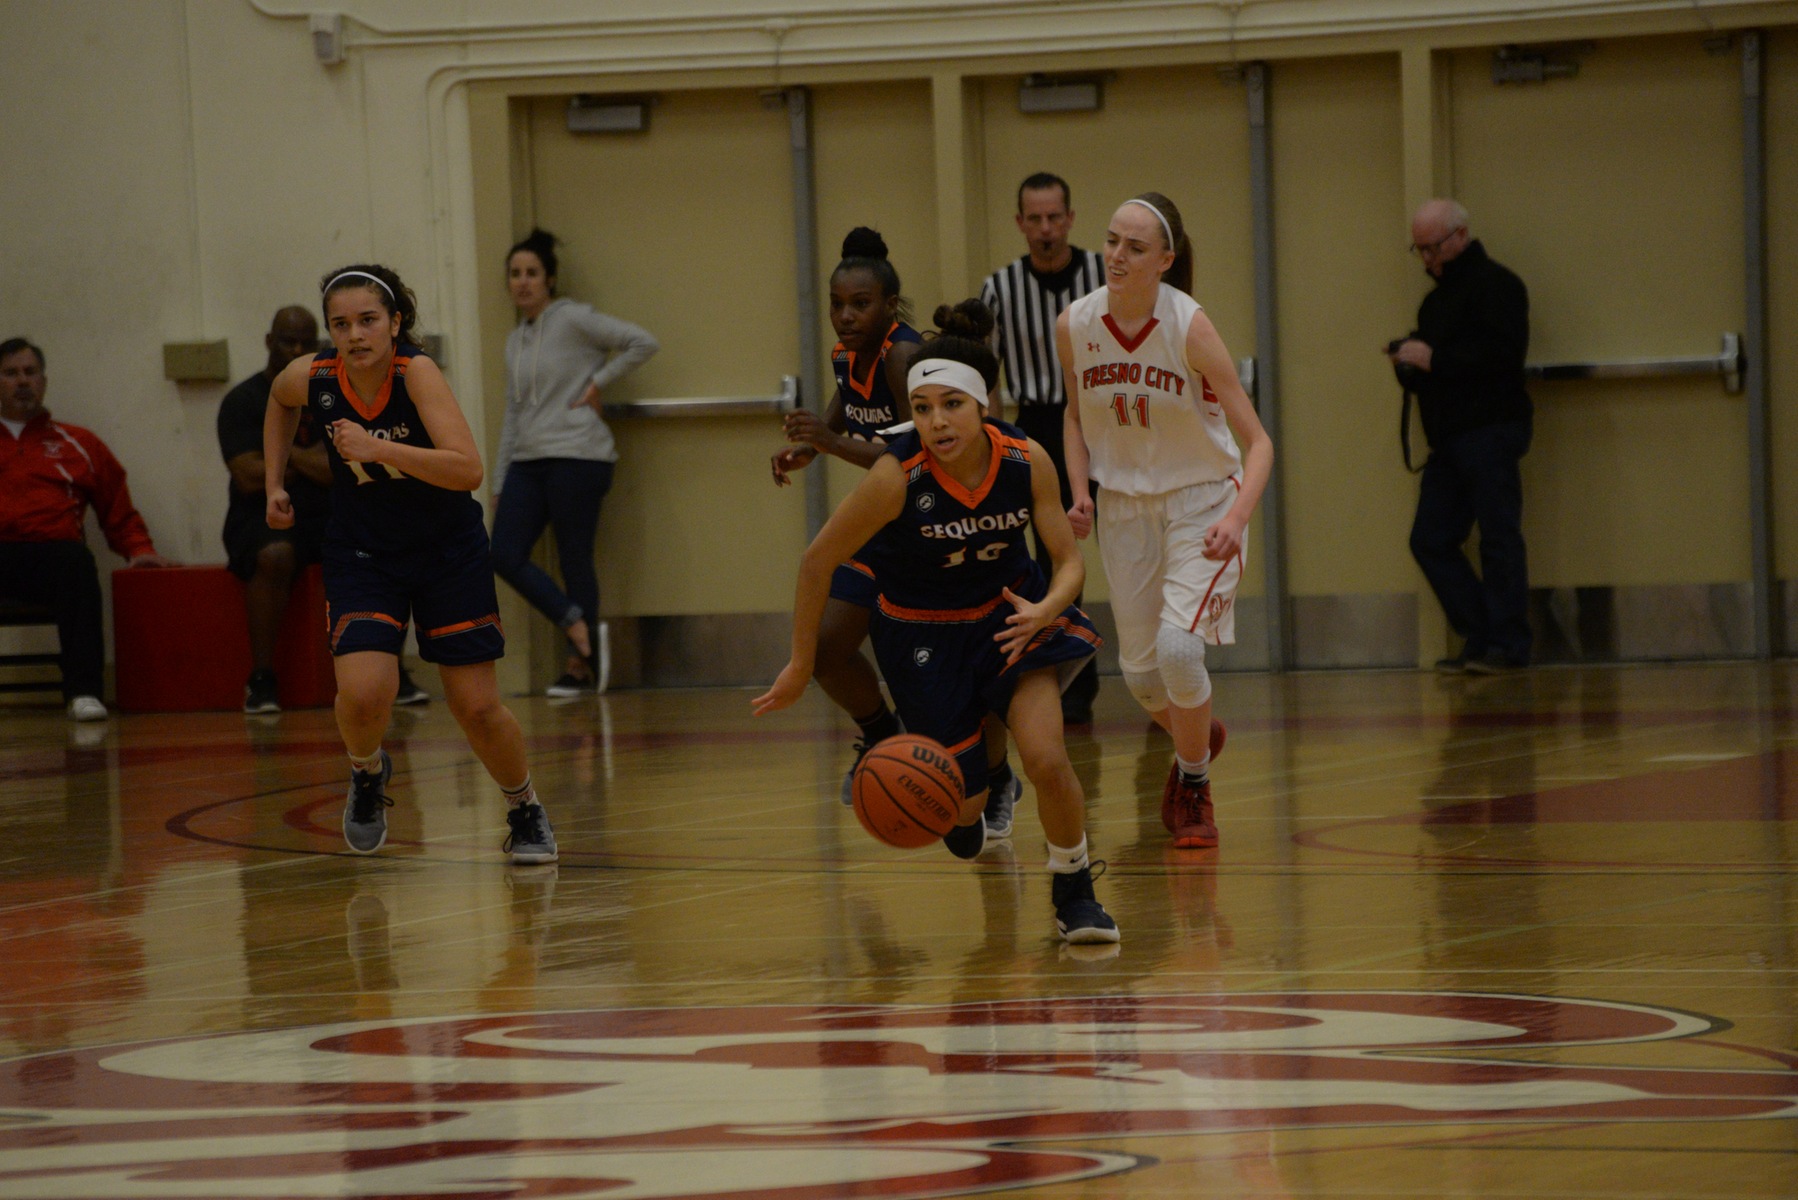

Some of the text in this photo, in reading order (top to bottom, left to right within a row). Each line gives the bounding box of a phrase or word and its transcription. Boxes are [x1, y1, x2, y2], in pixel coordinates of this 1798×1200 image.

[1083, 362, 1185, 396] FRESNO CITY
[1110, 393, 1150, 428] 11
[324, 422, 410, 440] SOIAS
[920, 508, 1029, 540] SEQUOIAS
